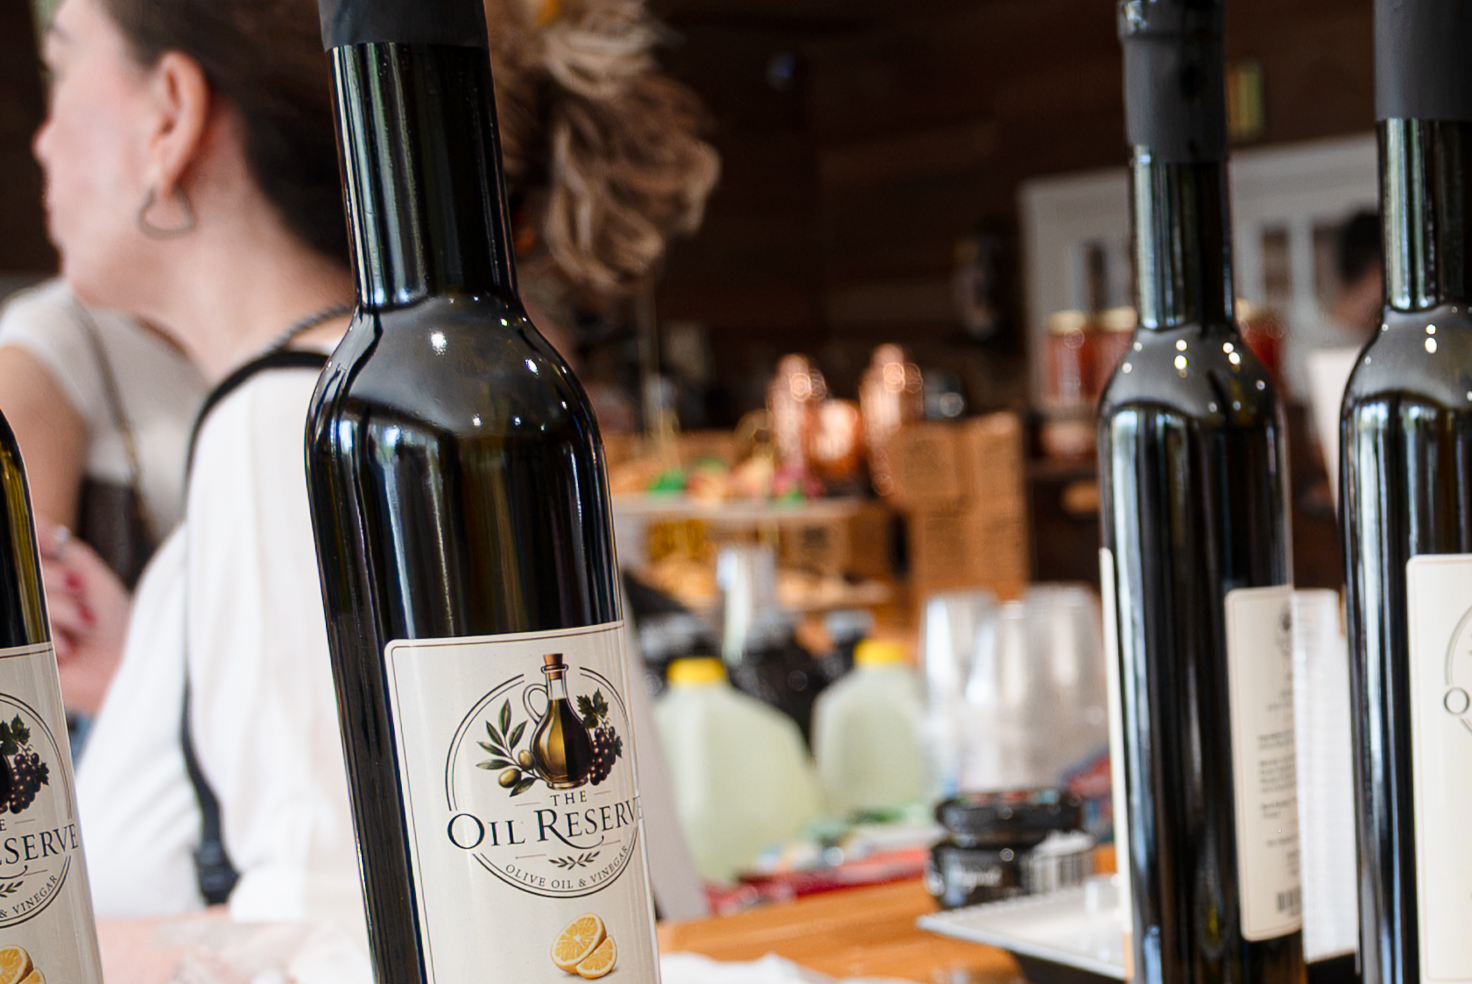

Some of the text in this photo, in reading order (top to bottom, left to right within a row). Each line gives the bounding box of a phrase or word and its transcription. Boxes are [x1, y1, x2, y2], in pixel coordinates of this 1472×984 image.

[550, 790, 588, 807] THE
[0, 823, 79, 879] SERVE
[447, 813, 526, 849] OIL
[505, 845, 629, 889] OLIVE OIL & VINEGAR
[12, 874, 57, 915] VINEGAR
